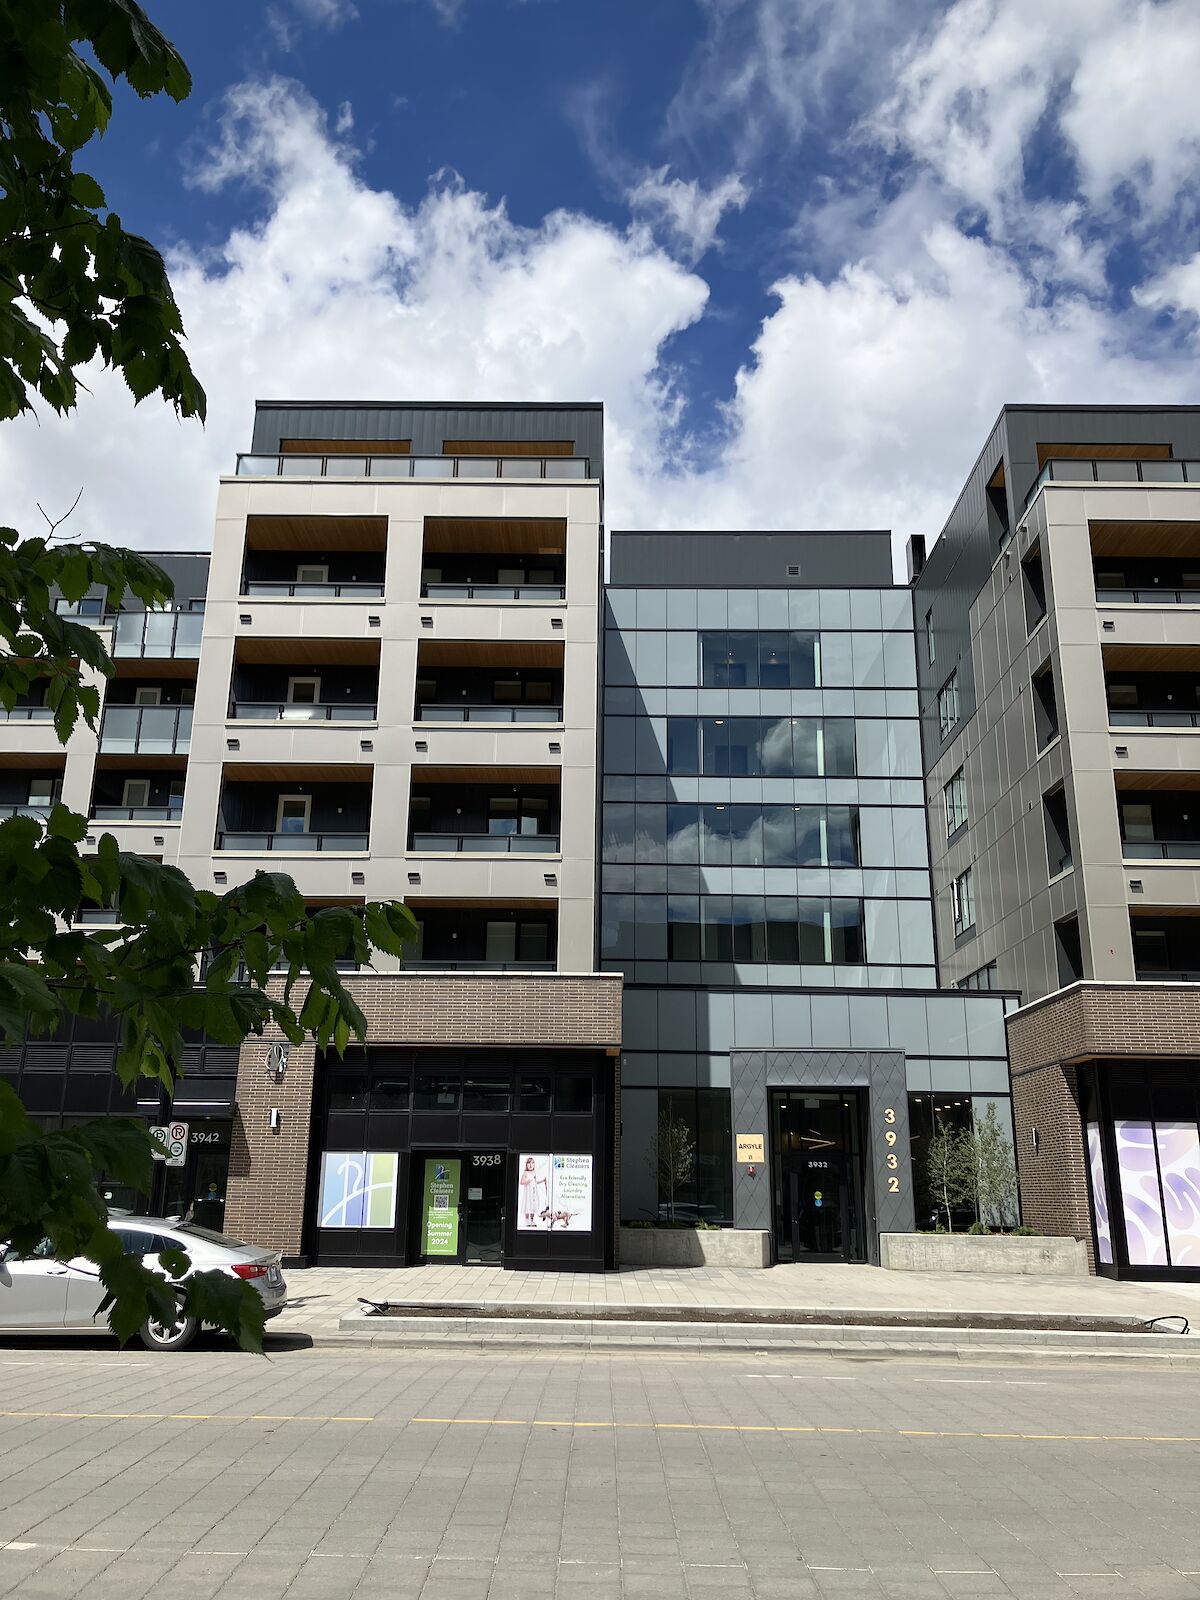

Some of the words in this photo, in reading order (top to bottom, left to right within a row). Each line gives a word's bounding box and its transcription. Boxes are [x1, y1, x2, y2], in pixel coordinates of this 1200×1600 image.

[190, 1132, 220, 1143] 3942
[472, 1154, 501, 1166] 3938
[426, 1221, 452, 1230] Opening
